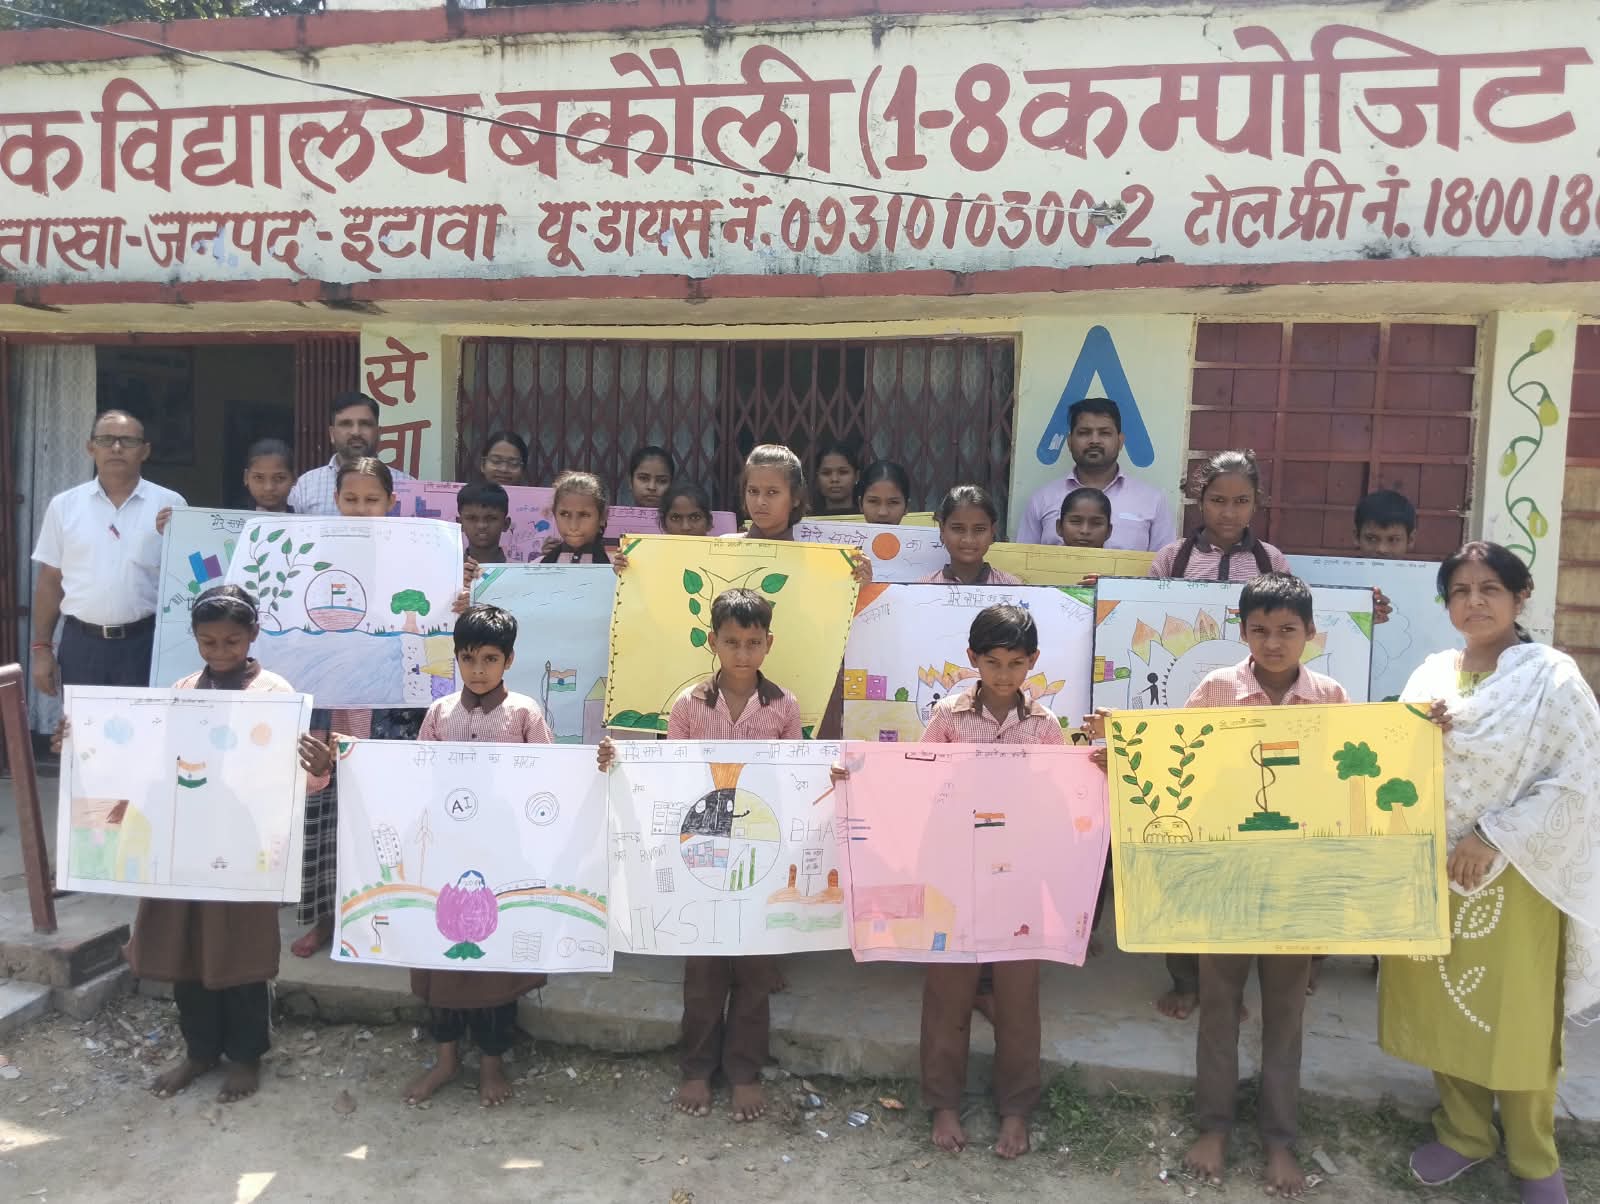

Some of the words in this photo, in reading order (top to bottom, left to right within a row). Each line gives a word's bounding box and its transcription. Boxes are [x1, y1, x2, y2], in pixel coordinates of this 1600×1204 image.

[92, 78, 486, 195] विद्यालय
[488, 45, 856, 180] बकौली
[1020, 24, 1594, 161] कम्पोजिट
[1423, 172, 1600, 238] 180018
[1037, 324, 1155, 468] A
[452, 796, 473, 814] AI
